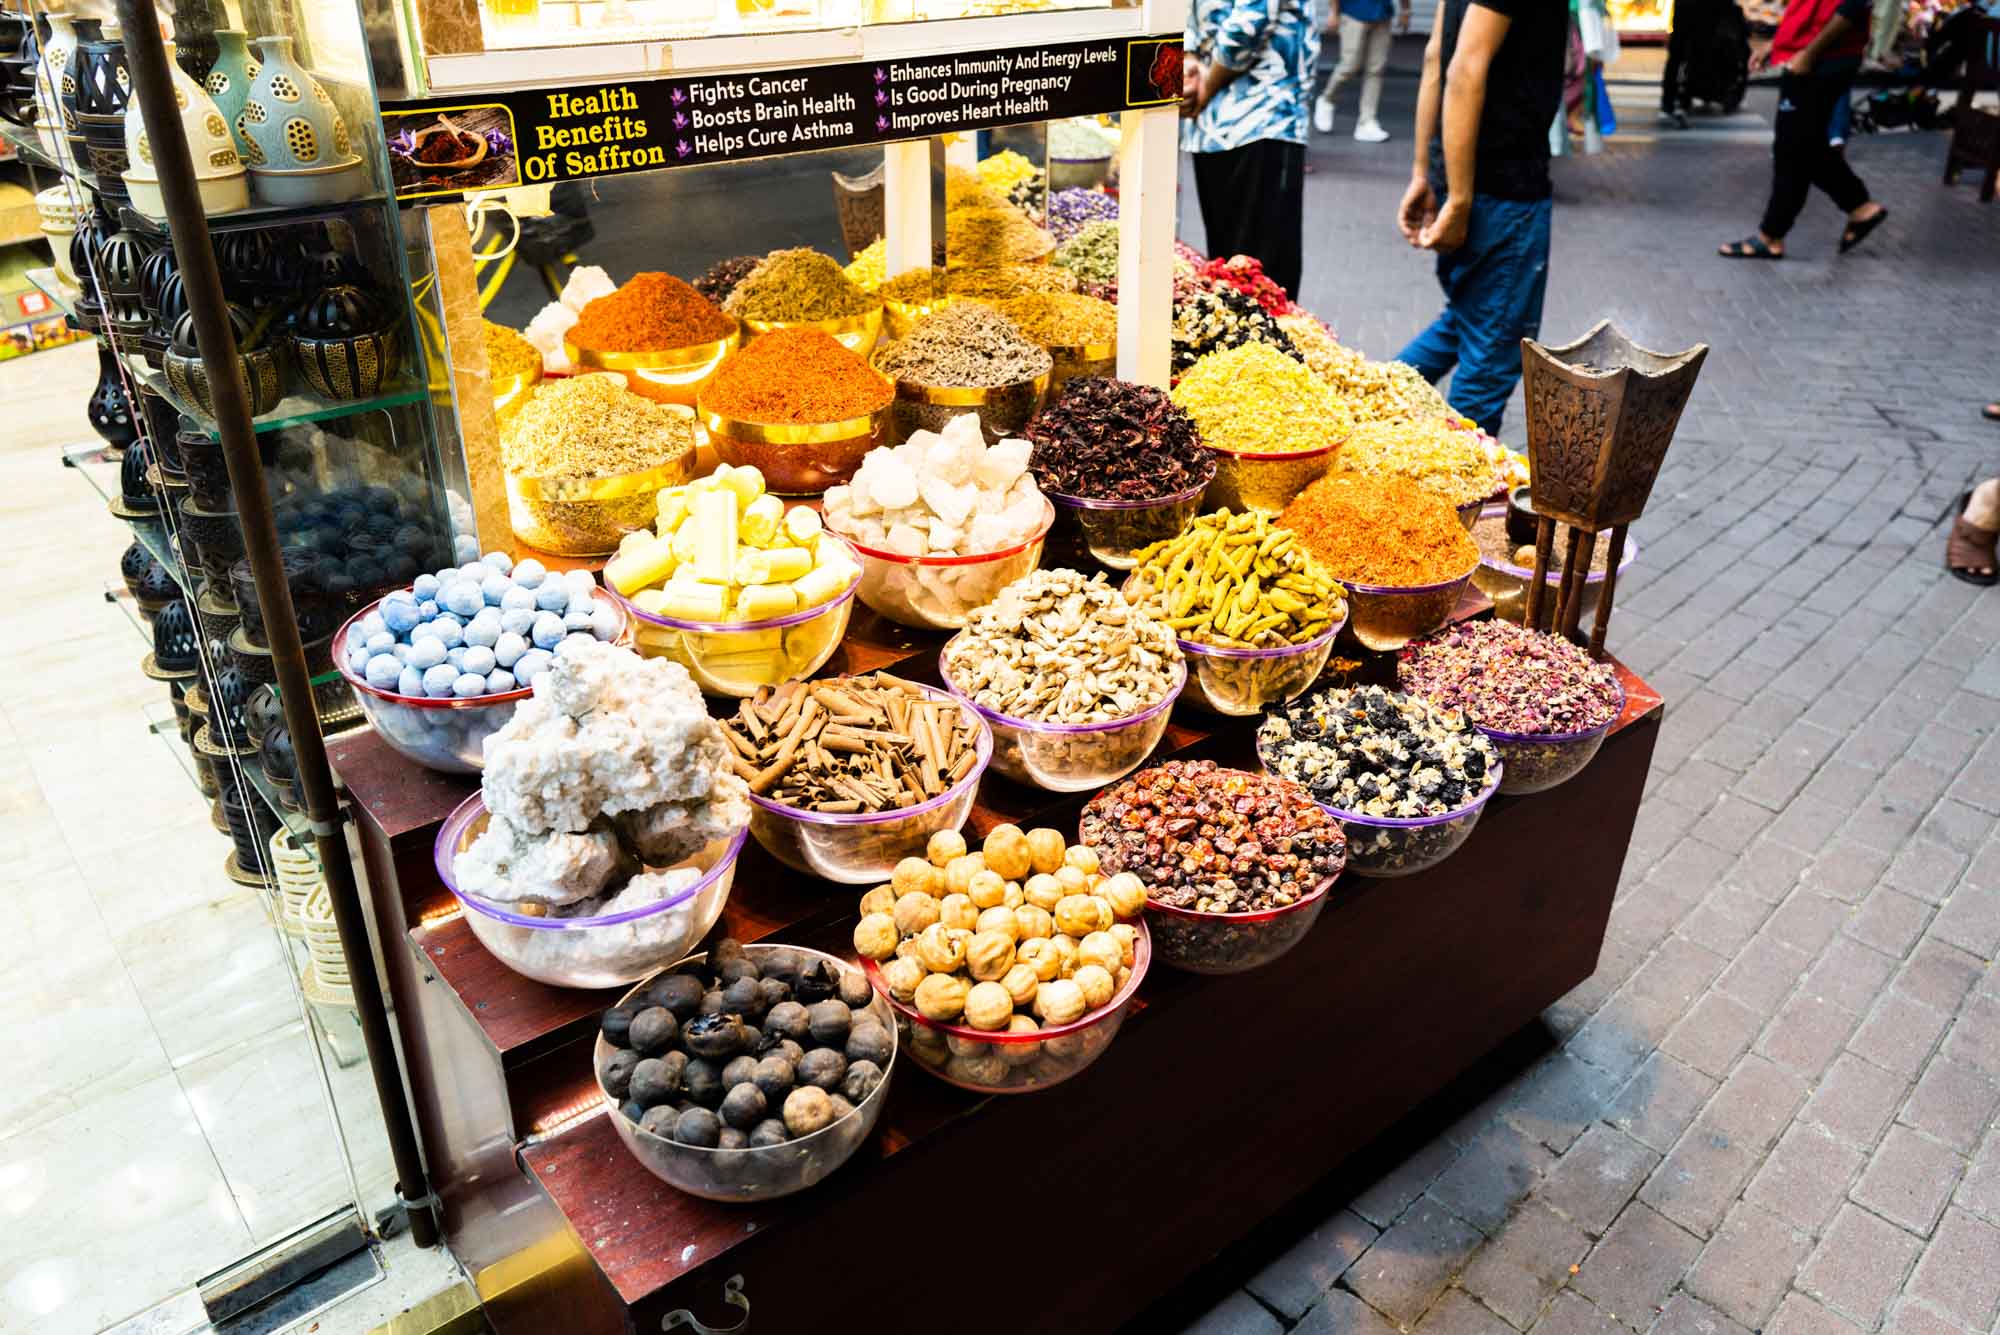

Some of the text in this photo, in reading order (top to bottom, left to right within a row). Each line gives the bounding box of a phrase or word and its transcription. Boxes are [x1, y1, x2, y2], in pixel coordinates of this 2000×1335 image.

[890, 45, 1117, 82] Enhances Immunity And Energy Levels
[546, 86, 639, 119] Health
[689, 77, 808, 106] Fights Cancer
[890, 74, 1072, 106] Is Good During Pregnancy
[692, 92, 856, 129] Boosts Brain Health
[891, 95, 1049, 132] Improves Heart Health
[535, 116, 648, 150] Benefits
[694, 119, 854, 155] Helps Cure Asthma
[524, 145, 666, 181] Of Saffron
